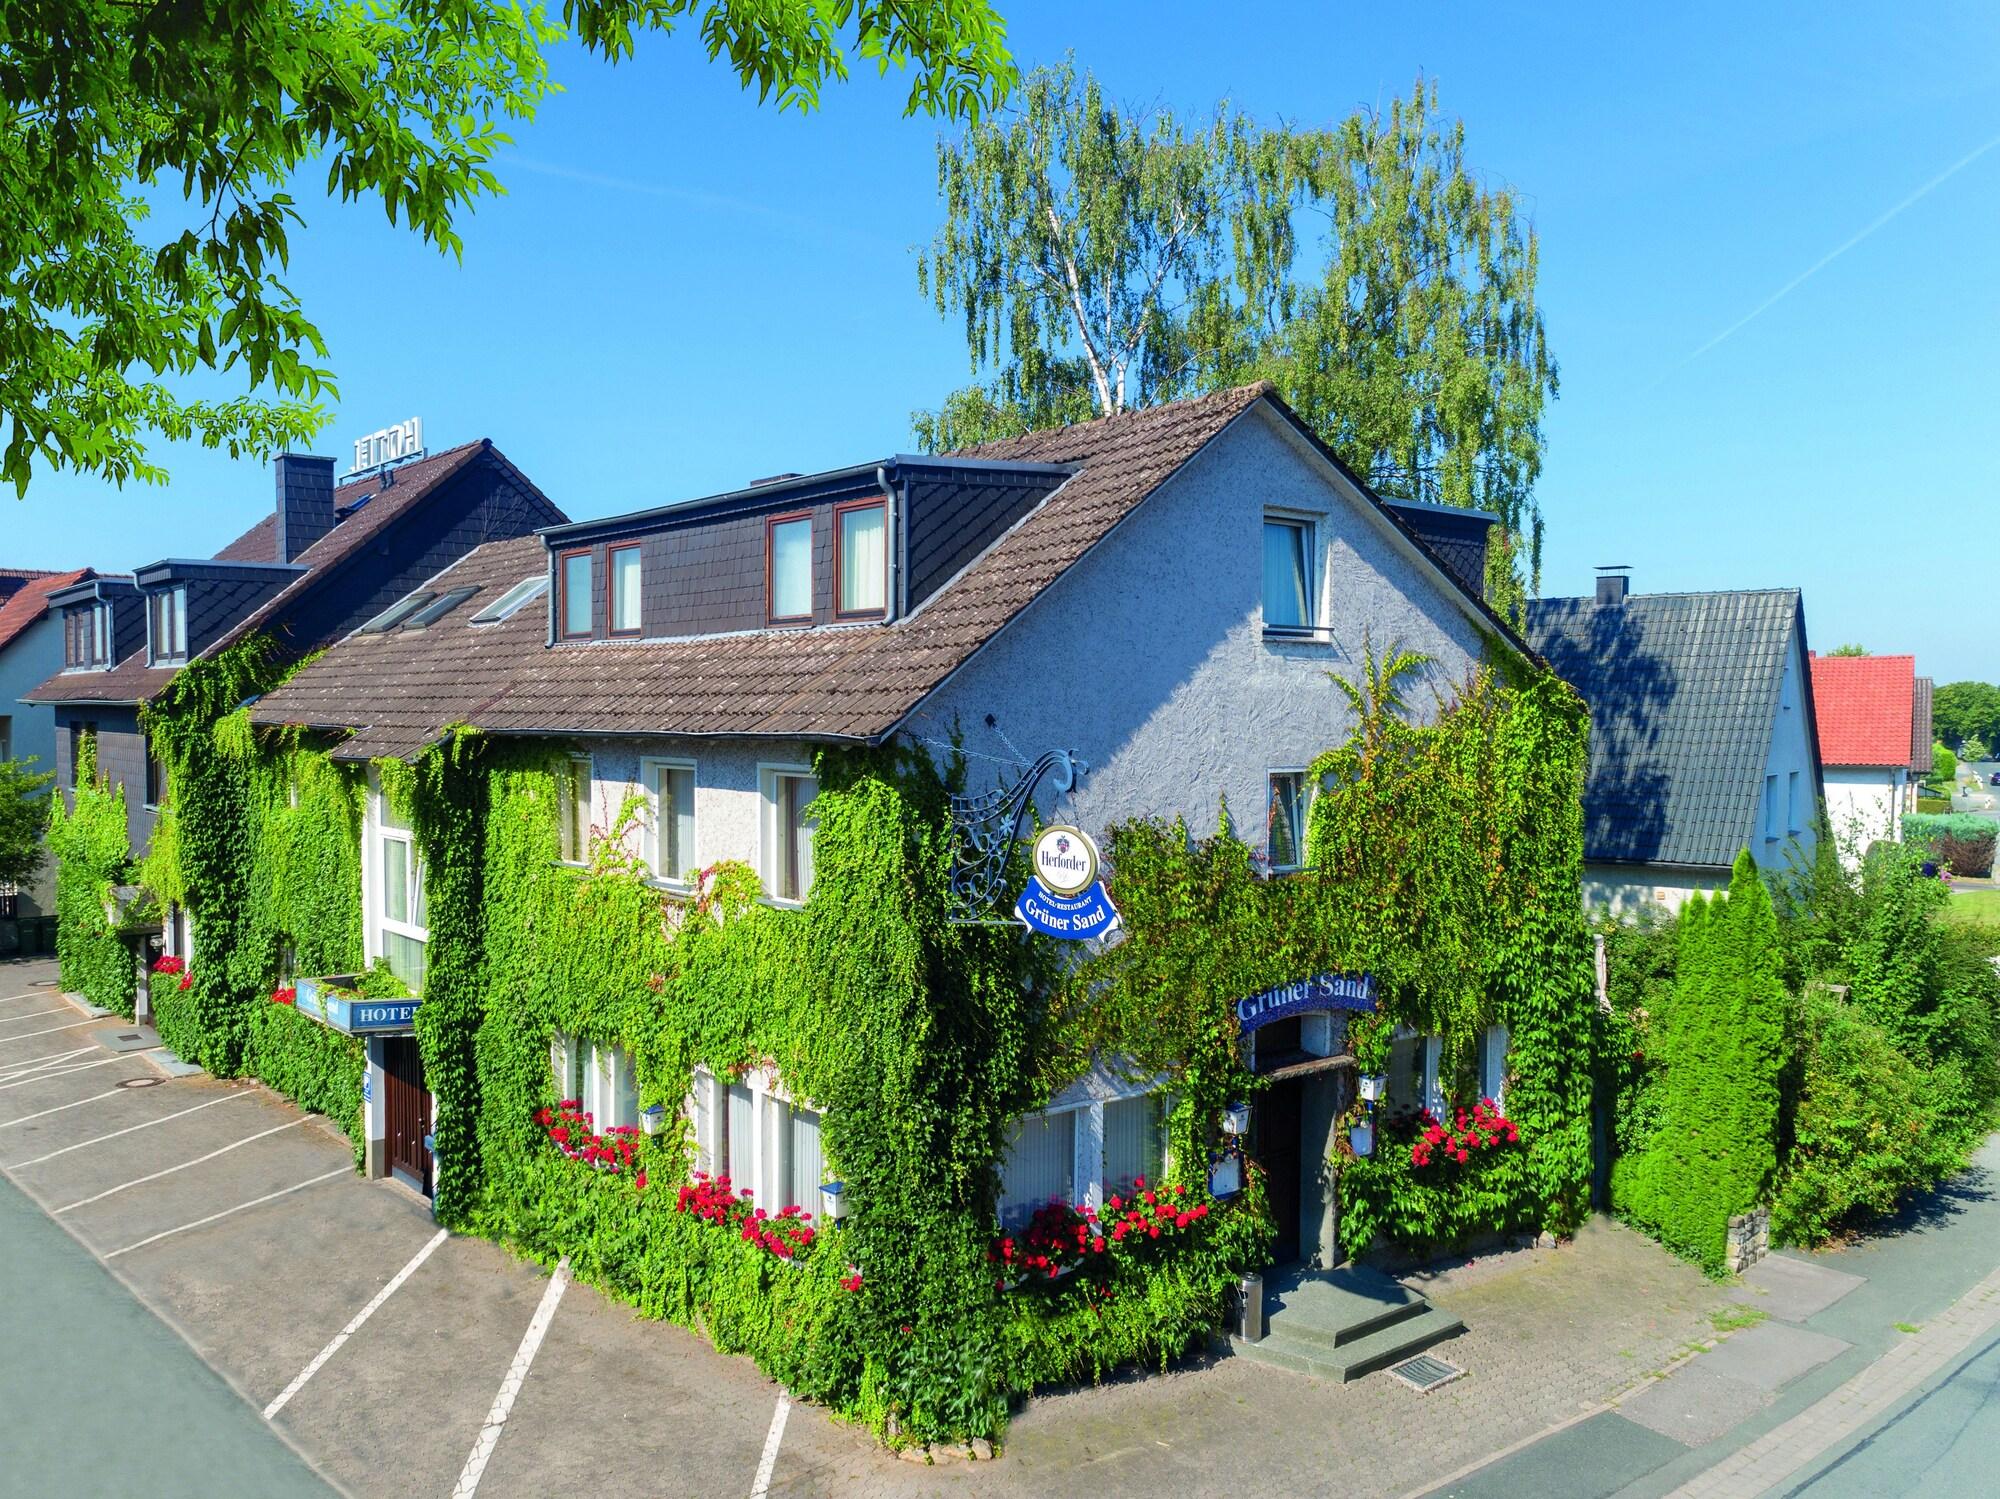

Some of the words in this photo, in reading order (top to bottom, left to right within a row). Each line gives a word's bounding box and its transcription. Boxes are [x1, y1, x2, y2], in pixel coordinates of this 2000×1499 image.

[1041, 850, 1086, 872] Herforder
[1025, 898, 1070, 930] Grüner
[1073, 904, 1106, 931] Sand
[1319, 972, 1369, 1000] Sand
